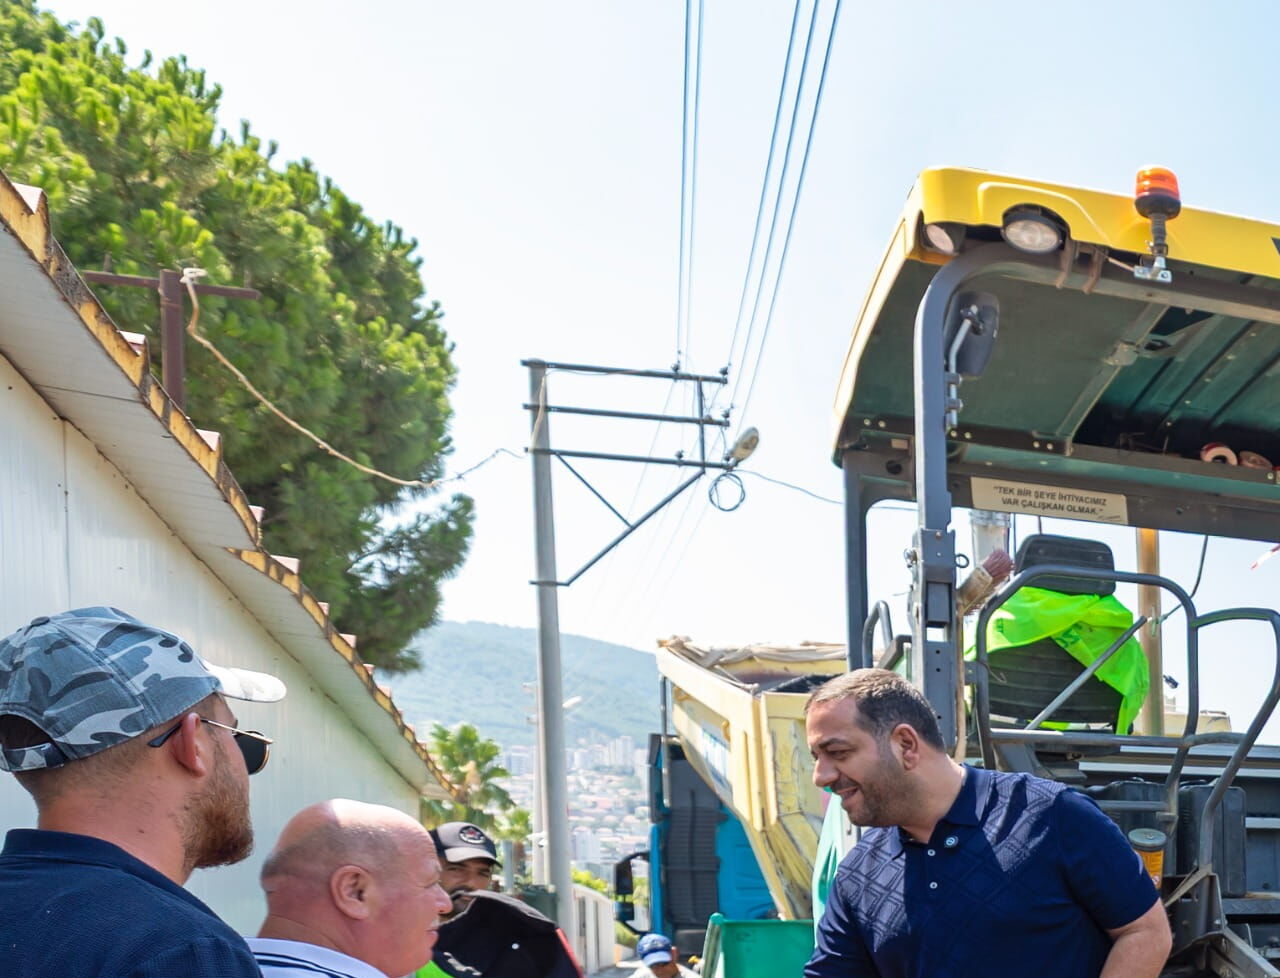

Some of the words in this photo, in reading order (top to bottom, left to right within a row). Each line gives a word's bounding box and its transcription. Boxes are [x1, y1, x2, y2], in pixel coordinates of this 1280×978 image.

[1034, 490, 1057, 500] ŞEYE
[1001, 497, 1019, 506] VAR
[1021, 499, 1064, 511] ÇALIŞKAN
